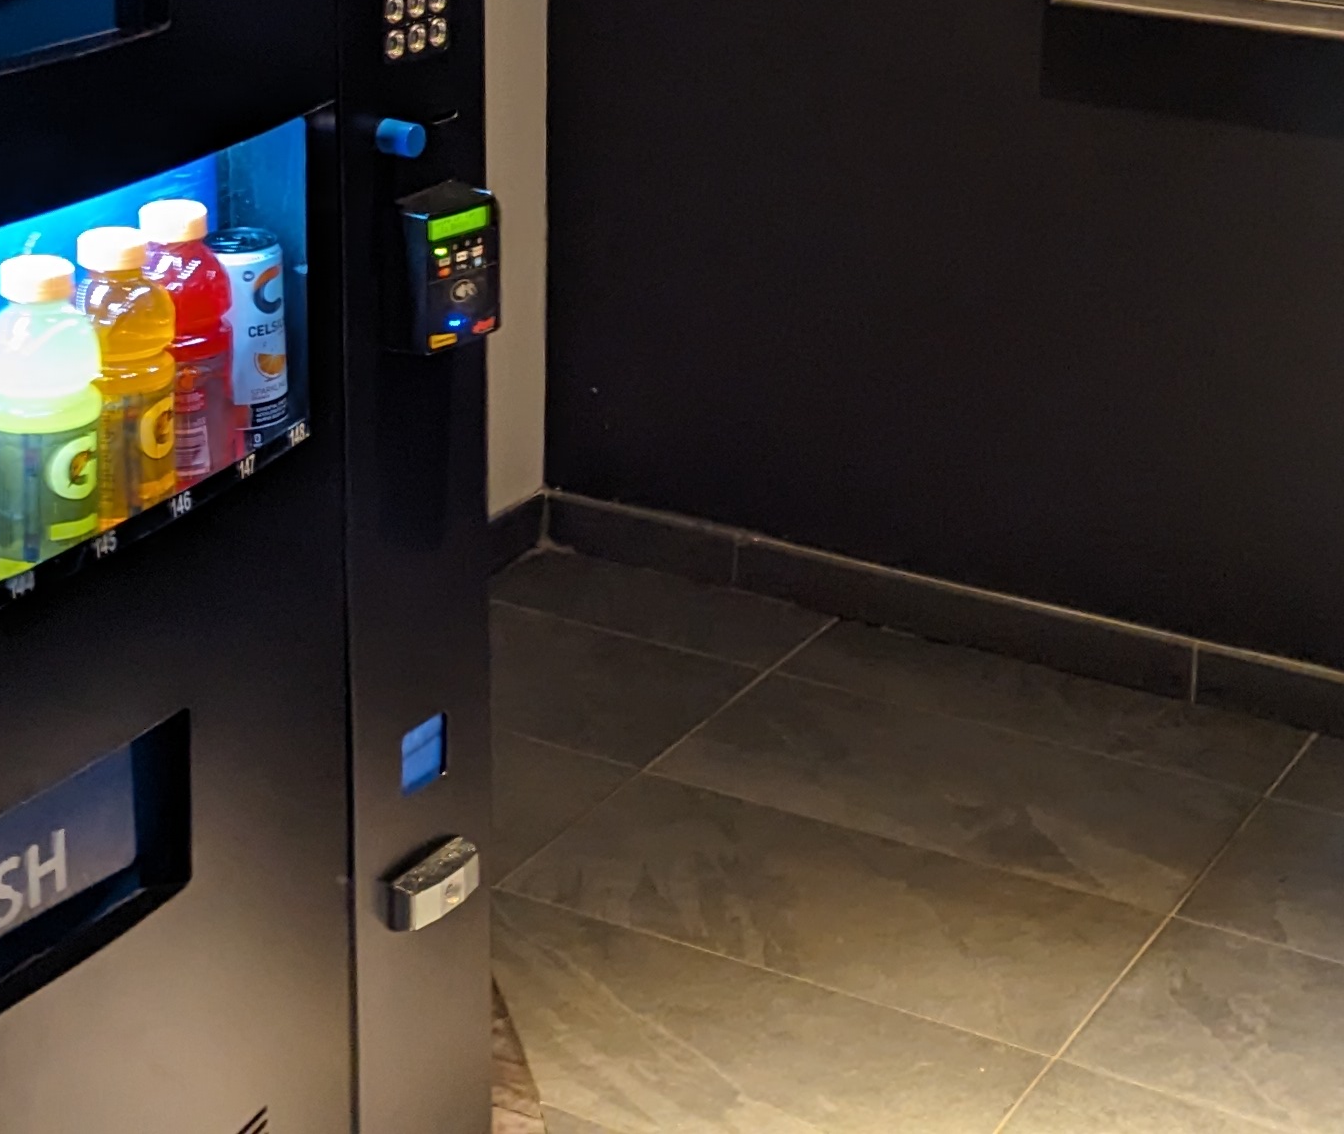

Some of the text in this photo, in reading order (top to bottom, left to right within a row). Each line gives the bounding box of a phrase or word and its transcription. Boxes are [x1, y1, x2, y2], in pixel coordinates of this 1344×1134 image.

[248, 320, 284, 338] CELSI
[46, 432, 98, 500] G
[238, 453, 256, 479] 147
[170, 489, 192, 518] 146
[94, 530, 118, 559] 145
